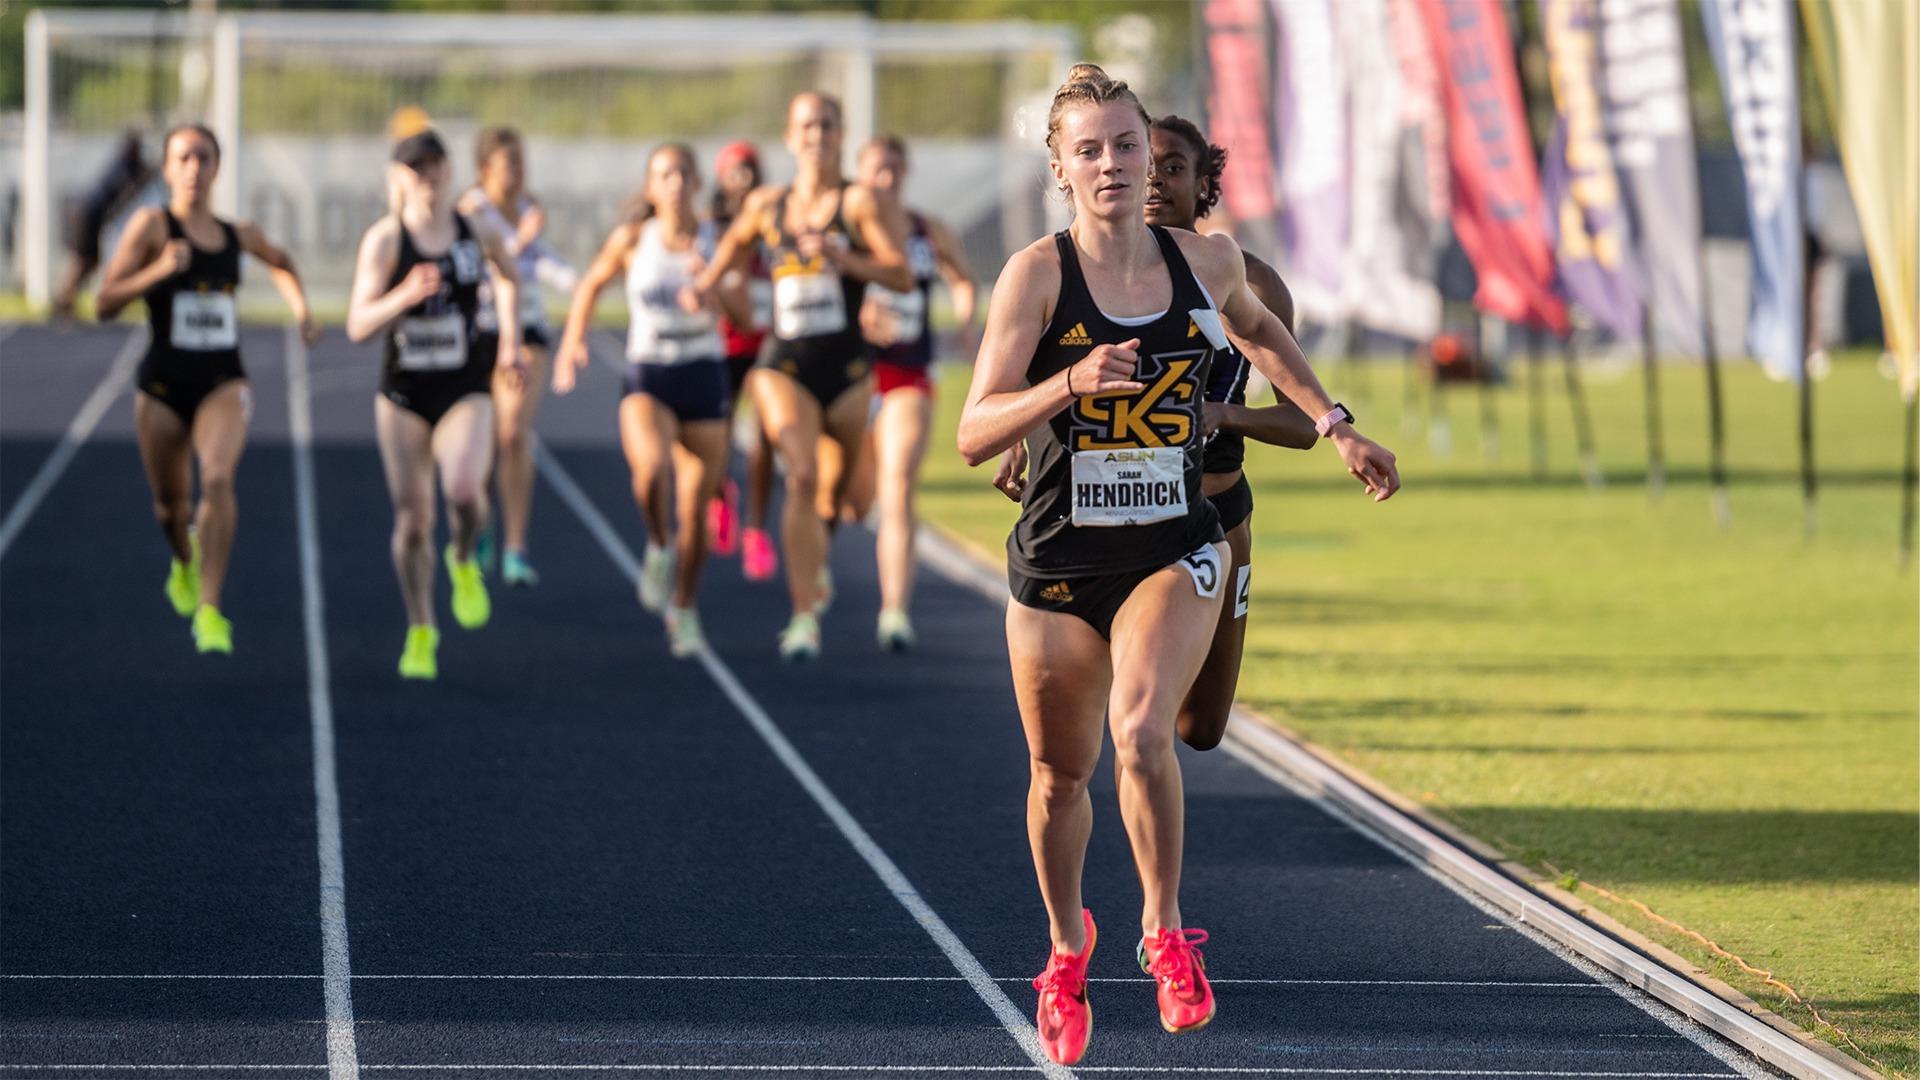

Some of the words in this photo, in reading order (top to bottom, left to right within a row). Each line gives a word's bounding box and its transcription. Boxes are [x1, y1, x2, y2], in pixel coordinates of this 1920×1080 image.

[1059, 336, 1093, 346] adidas
[1104, 450, 1156, 463] ASUN
[1117, 470, 1143, 480] SARAH
[1077, 480, 1182, 508] HENDRICK
[1183, 551, 1217, 593] 5
